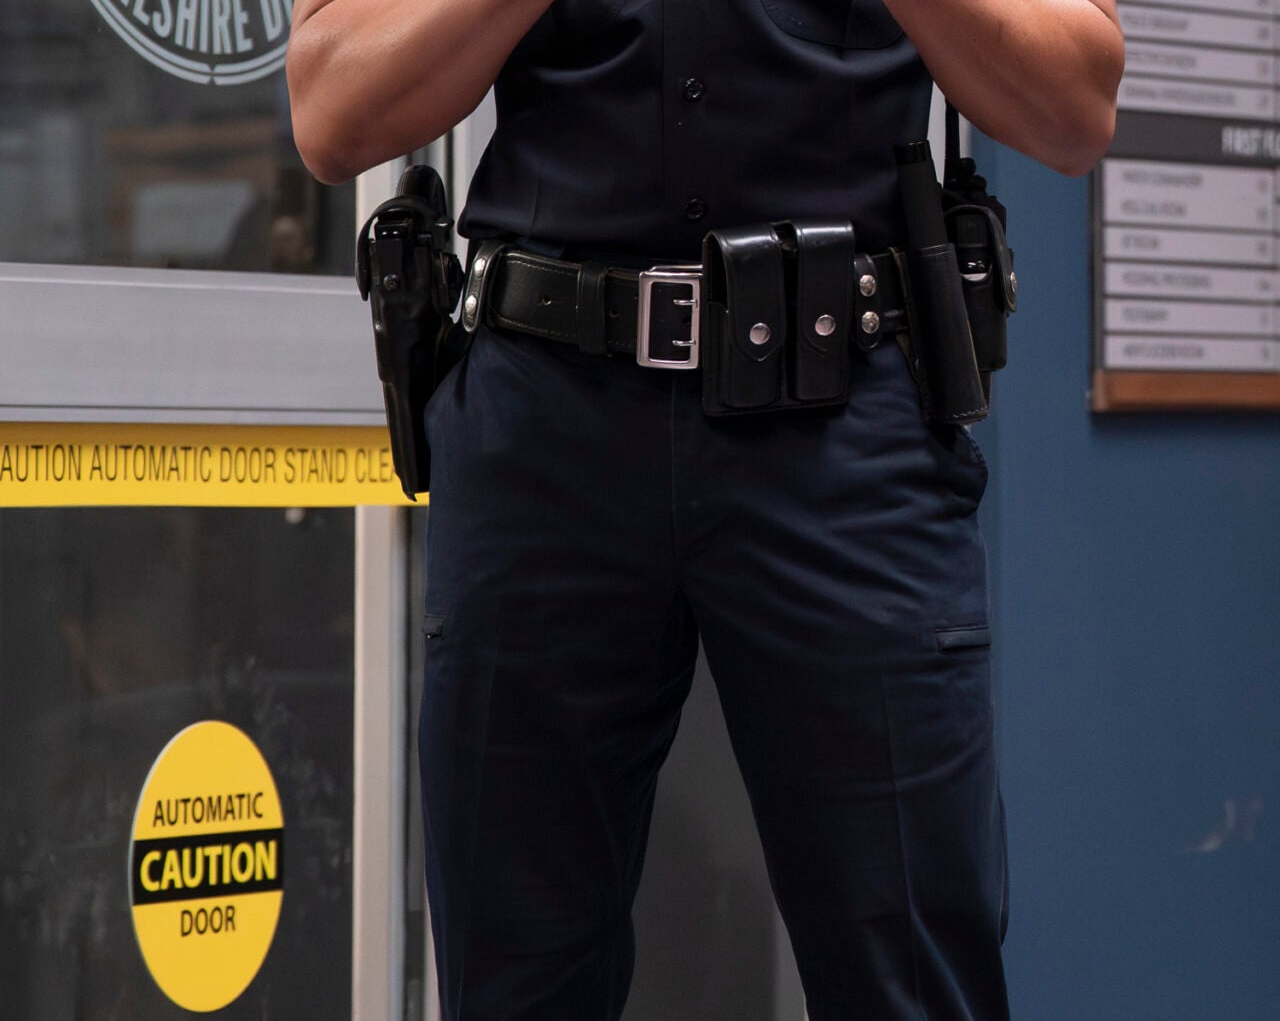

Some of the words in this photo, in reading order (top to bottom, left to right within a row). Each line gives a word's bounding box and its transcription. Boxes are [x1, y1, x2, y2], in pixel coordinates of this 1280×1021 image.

[0, 444, 82, 482] AUTION
[90, 444, 212, 482] AUTOMATIC
[219, 446, 277, 483] DOOR
[283, 447, 347, 483] STAND
[153, 792, 264, 827] AUTOMATIC
[140, 840, 277, 892] CAUTION
[180, 905, 236, 937] DOOR
